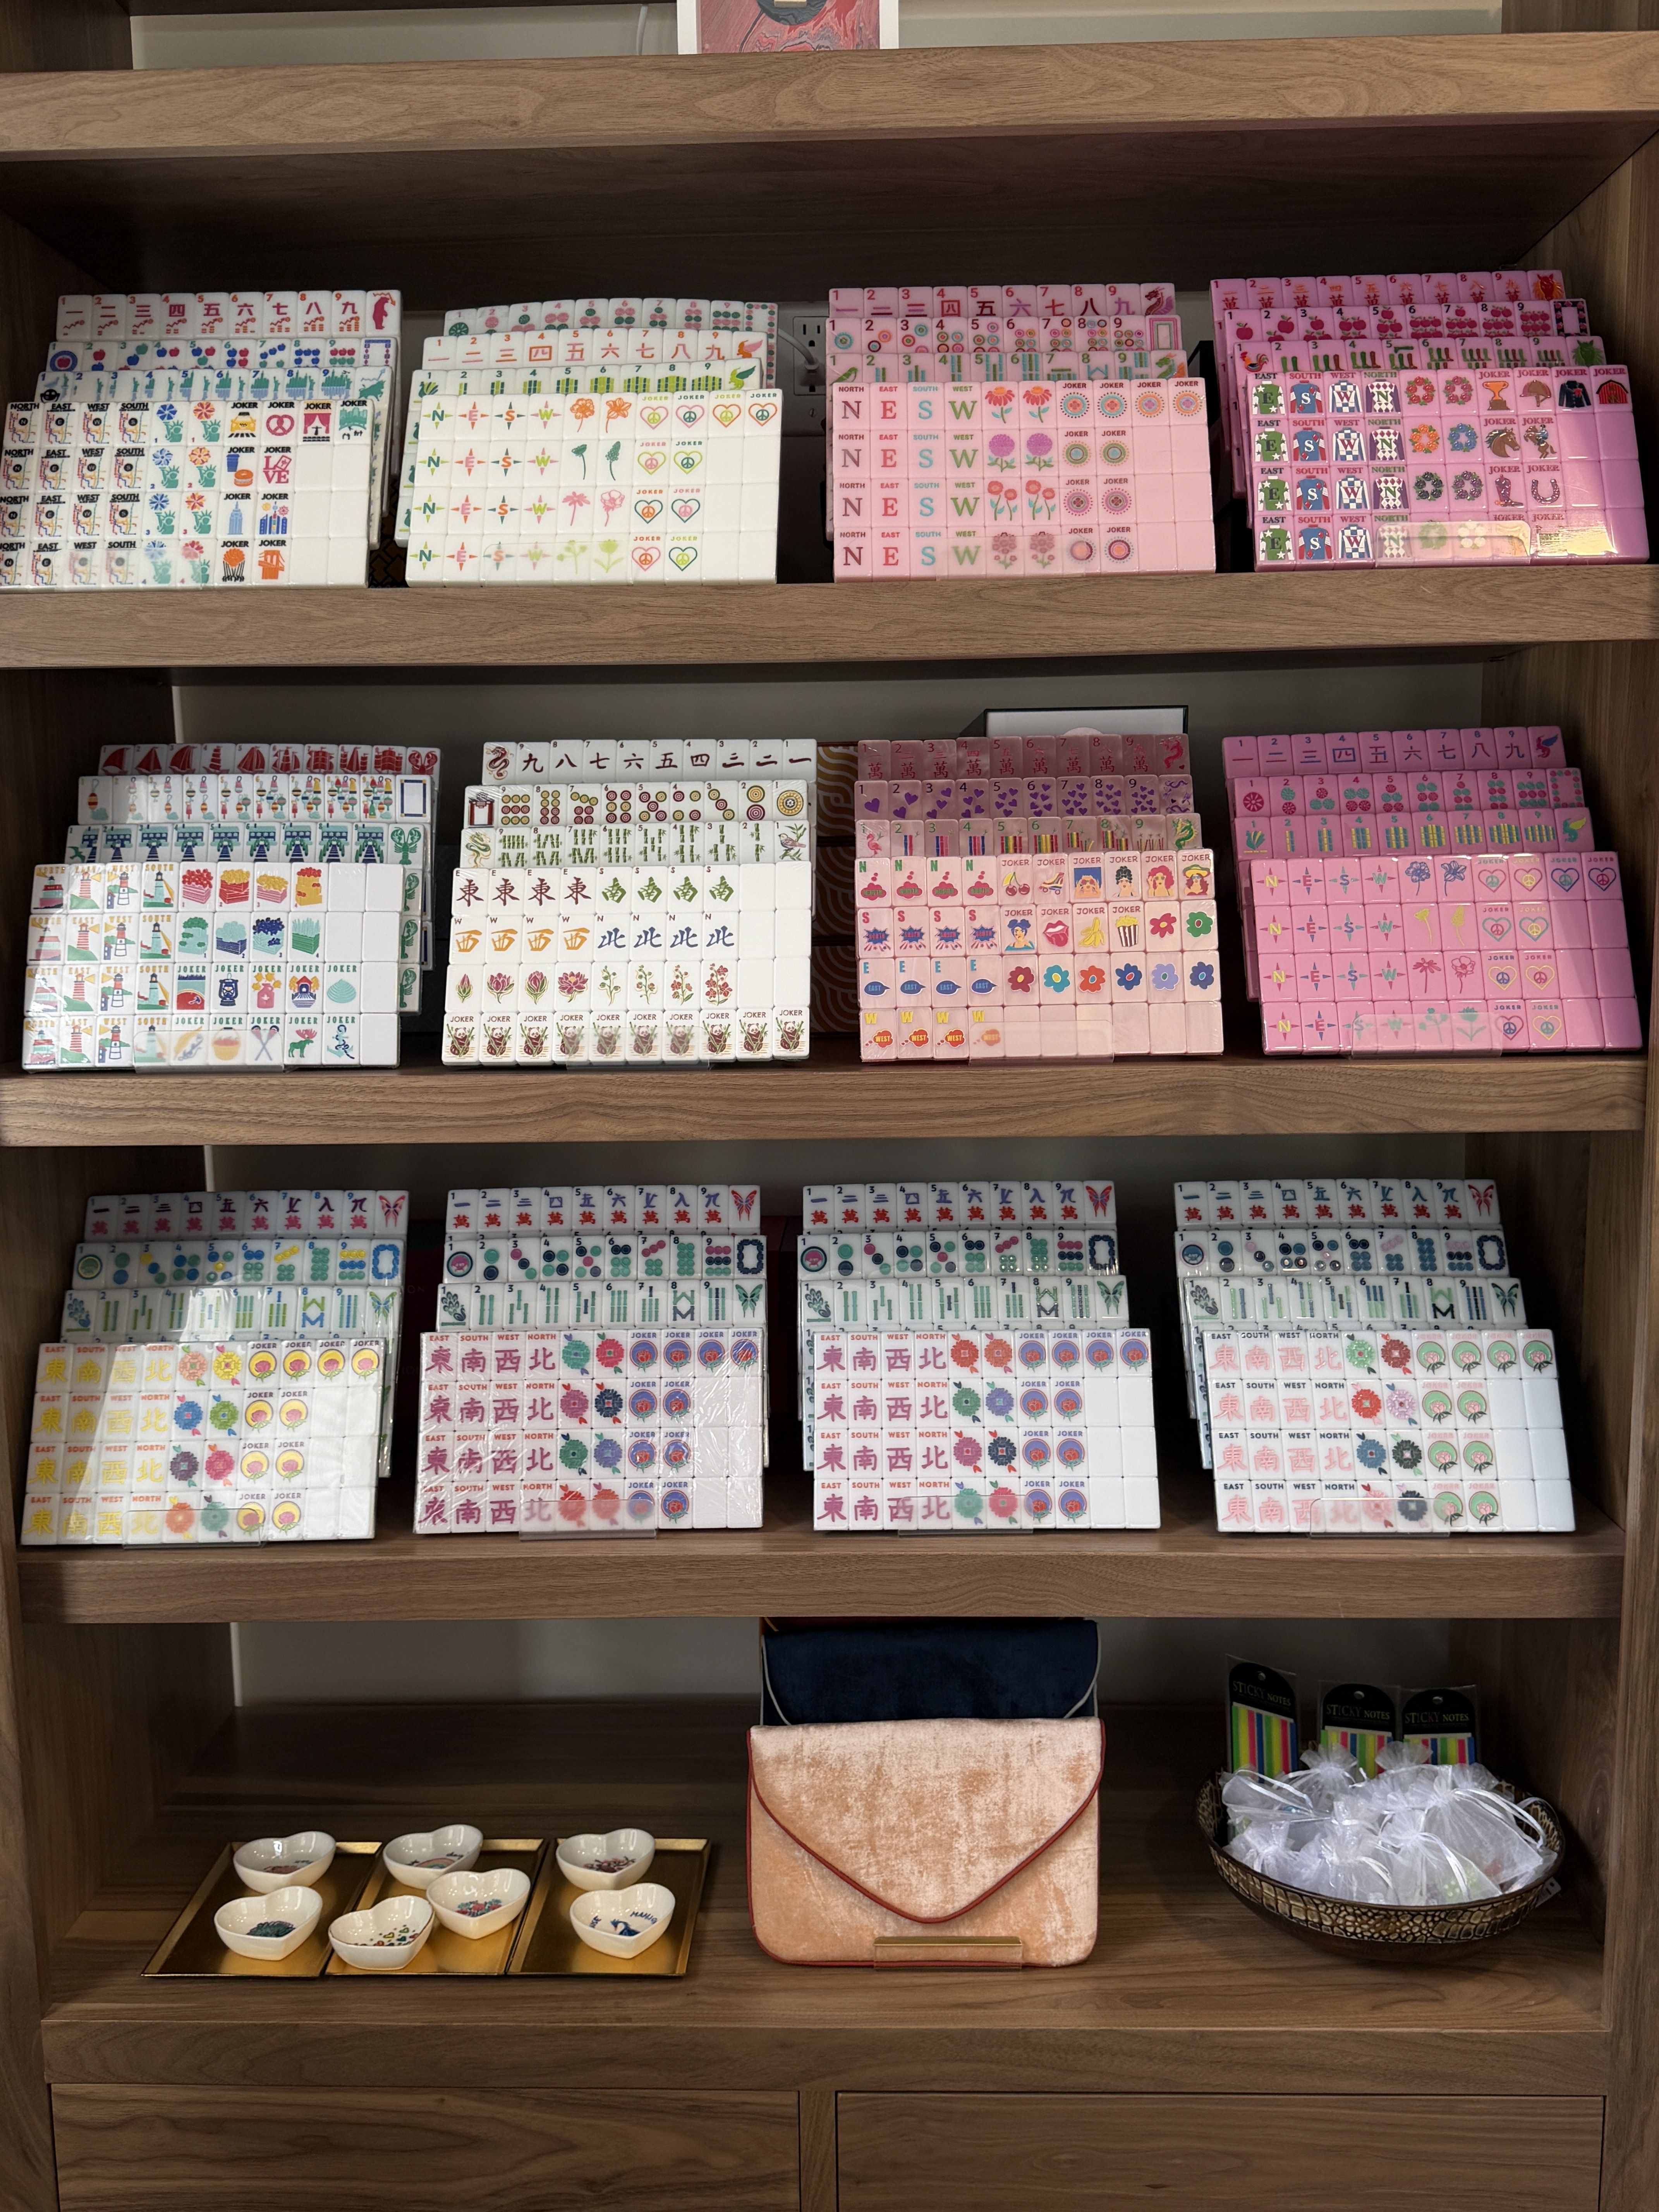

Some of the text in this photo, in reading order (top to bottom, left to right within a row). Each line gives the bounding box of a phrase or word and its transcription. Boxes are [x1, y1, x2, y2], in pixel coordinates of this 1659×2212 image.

[937, 288, 945, 298] 4
[1006, 287, 1014, 297] 6
[169, 304, 185, 317] 四
[203, 303, 220, 316] 五
[237, 303, 254, 316] 六
[306, 302, 321, 314] 八
[342, 302, 357, 314] 九
[941, 300, 961, 317] 四
[1444, 304, 1451, 313] 7
[1481, 303, 1488, 312] 8
[1114, 318, 1122, 328] 9
[529, 346, 552, 362] 四
[565, 343, 584, 361] 五
[601, 343, 619, 358] 六
[636, 343, 654, 358] 七
[1479, 371, 1510, 380] JOKER
[1594, 368, 1627, 376] JOKER
[1302, 393, 1310, 404] S
[1338, 390, 1352, 401] W
[432, 410, 444, 421] N
[469, 410, 478, 423] E
[505, 410, 515, 421] S
[539, 409, 554, 420] W
[842, 401, 862, 419] N
[881, 401, 896, 419] E
[919, 400, 933, 419] S
[948, 401, 977, 420] W
[1484, 418, 1516, 426] JOKER
[1333, 748, 1356, 763] 四
[1403, 746, 1422, 760] 六
[1437, 744, 1456, 759] 七
[1505, 743, 1525, 758] 九
[522, 753, 543, 773] 九
[555, 754, 577, 768] 八
[590, 752, 610, 769] 七
[624, 753, 644, 769] 六
[655, 752, 678, 769] 五
[690, 754, 709, 766] 四
[994, 782, 1000, 791] 5
[1061, 780, 1068, 790] 7
[1095, 779, 1103, 788] 8
[963, 822, 971, 833] 4
[1032, 820, 1039, 830] 6
[859, 861, 866, 872] N
[1266, 876, 1278, 887] N
[1303, 875, 1312, 886] E
[1340, 874, 1350, 886] S
[457, 879, 484, 907] 東
[602, 877, 626, 903] 南
[862, 912, 869, 923] S
[455, 930, 482, 952] 西
[598, 927, 626, 948] 北
[864, 962, 869, 974] E
[865, 1013, 877, 1024] W
[1058, 1233, 1063, 1242] 9
[425, 1346, 453, 1374] 東
[462, 1348, 486, 1372] 南
[495, 1349, 521, 1373] 西
[529, 1347, 555, 1370] 北
[817, 1345, 845, 1372] 東
[853, 1347, 876, 1371] 南
[885, 1348, 911, 1372] 西
[919, 1347, 946, 1369] 北
[39, 1357, 68, 1384] 東
[145, 1358, 172, 1381] 北
[1213, 1393, 1245, 1421] 東
[1250, 1396, 1276, 1422] 南
[1283, 1398, 1310, 1422] 西
[1320, 1395, 1350, 1422] 北
[1233, 1681, 1264, 1698] STICKY
[1267, 1693, 1291, 1706] NOTES
[1326, 1705, 1389, 1719] STICKY NOTES
[1405, 1713, 1440, 1723] STICKY
